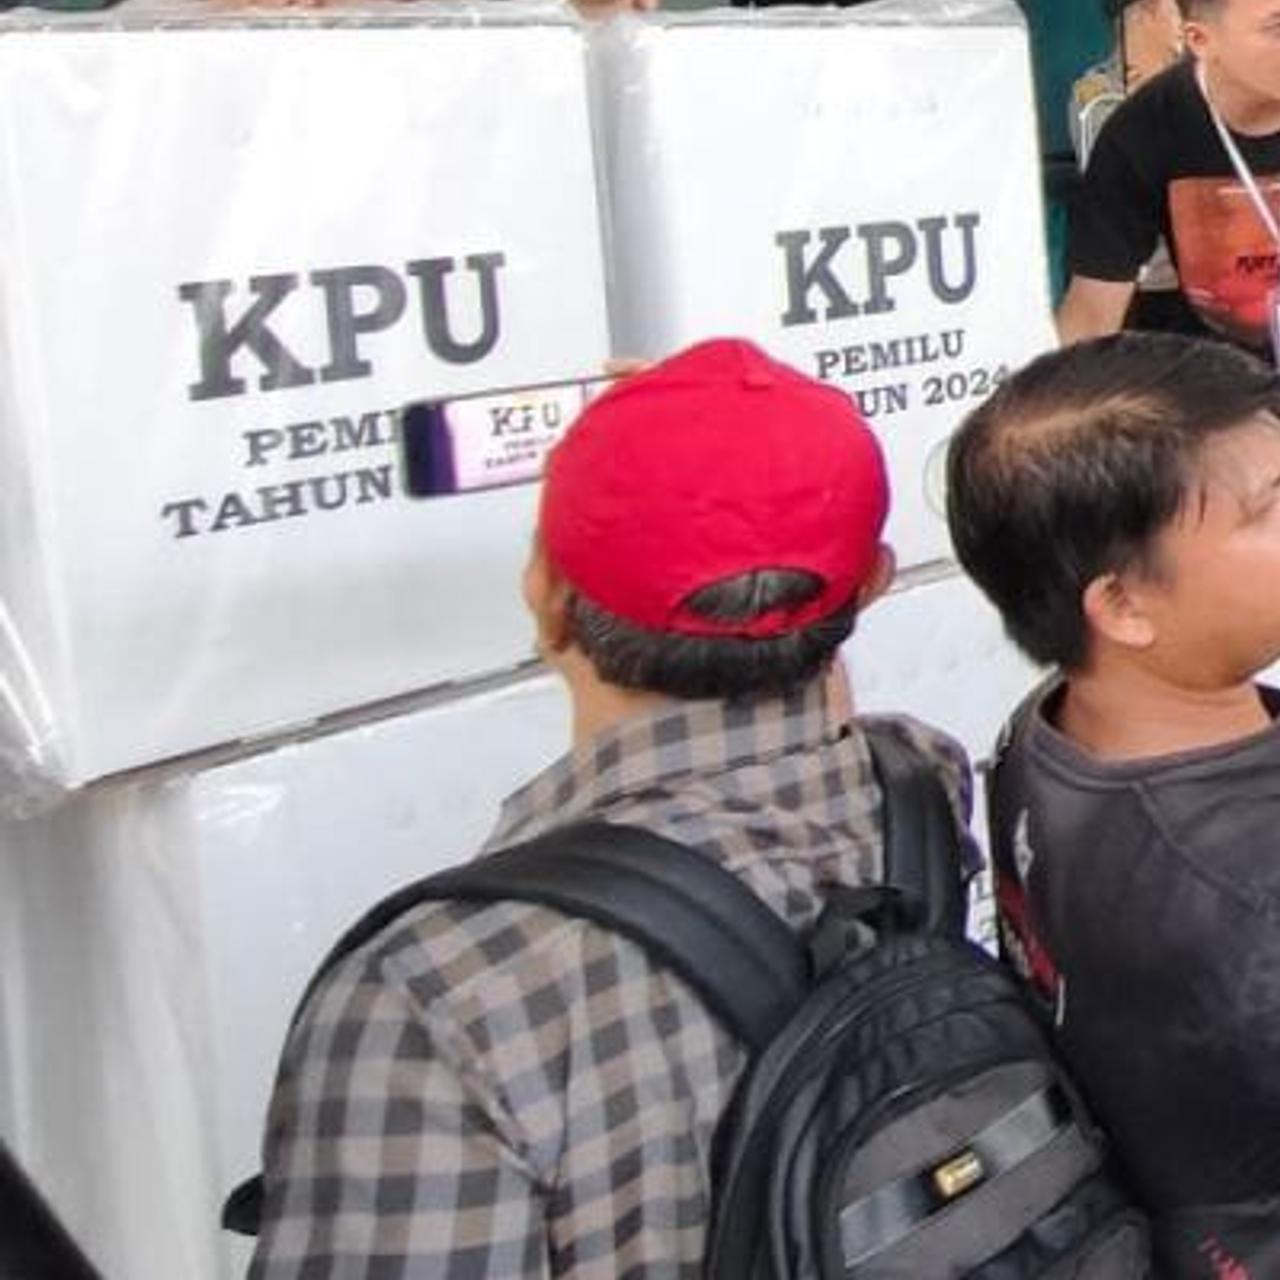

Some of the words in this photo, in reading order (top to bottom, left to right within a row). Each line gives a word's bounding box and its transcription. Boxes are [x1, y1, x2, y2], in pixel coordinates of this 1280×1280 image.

[774, 212, 982, 328] KPU
[178, 251, 507, 402] KPU
[812, 328, 967, 380] PEMILU
[242, 408, 402, 468] PEMI
[160, 464, 396, 540] TAHUN
